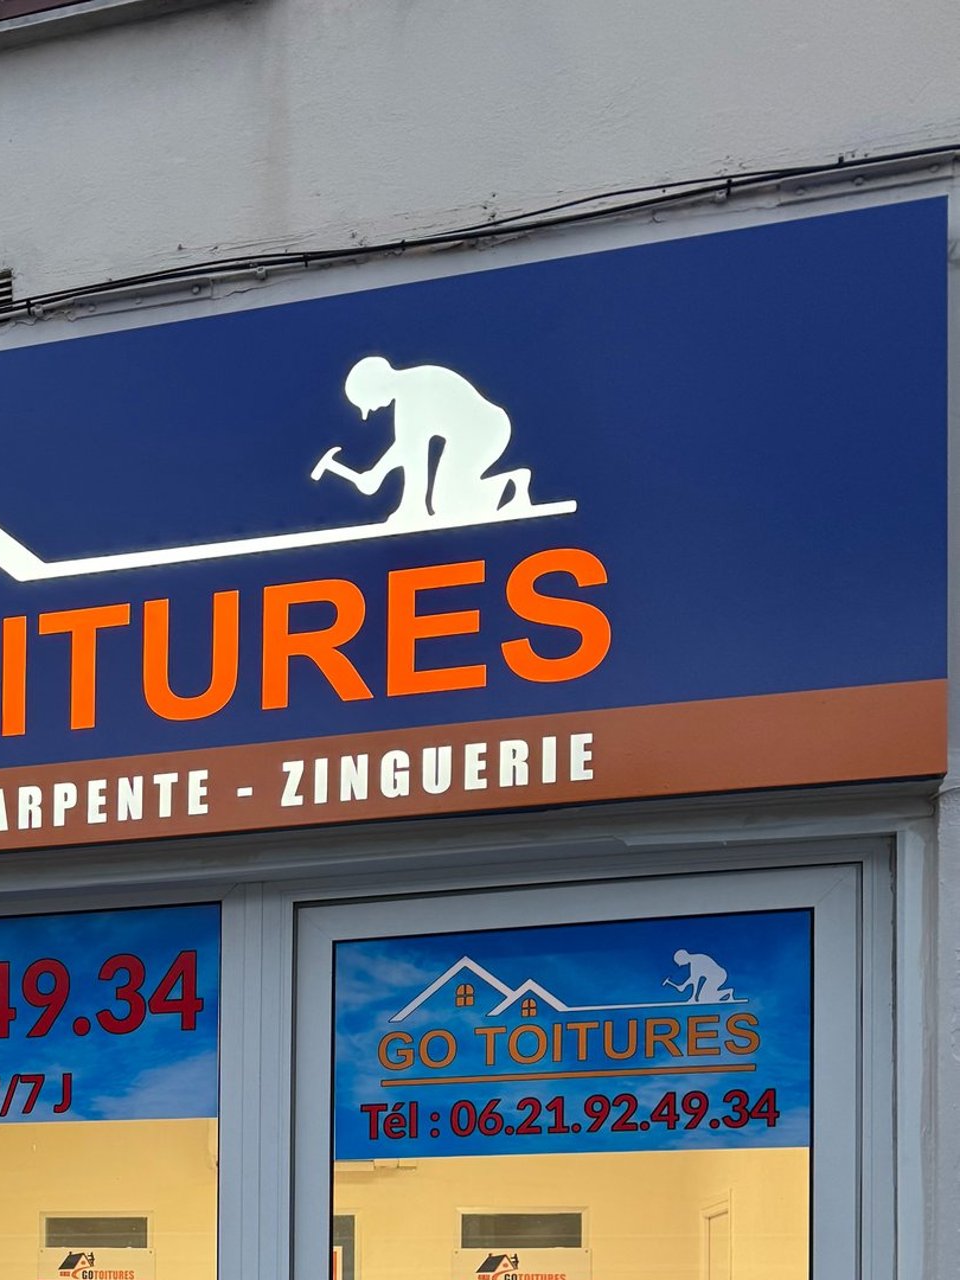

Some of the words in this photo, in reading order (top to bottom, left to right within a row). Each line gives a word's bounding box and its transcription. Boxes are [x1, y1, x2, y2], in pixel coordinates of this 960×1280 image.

[281, 732, 595, 807] ZINGUERIE
[377, 1029, 457, 1071] GO
[474, 1012, 761, 1067] TOITURES
[53, 1072, 74, 1115] J
[360, 1101, 418, 1141] Tél
[450, 1088, 779, 1138] 06.21.92.49.34
